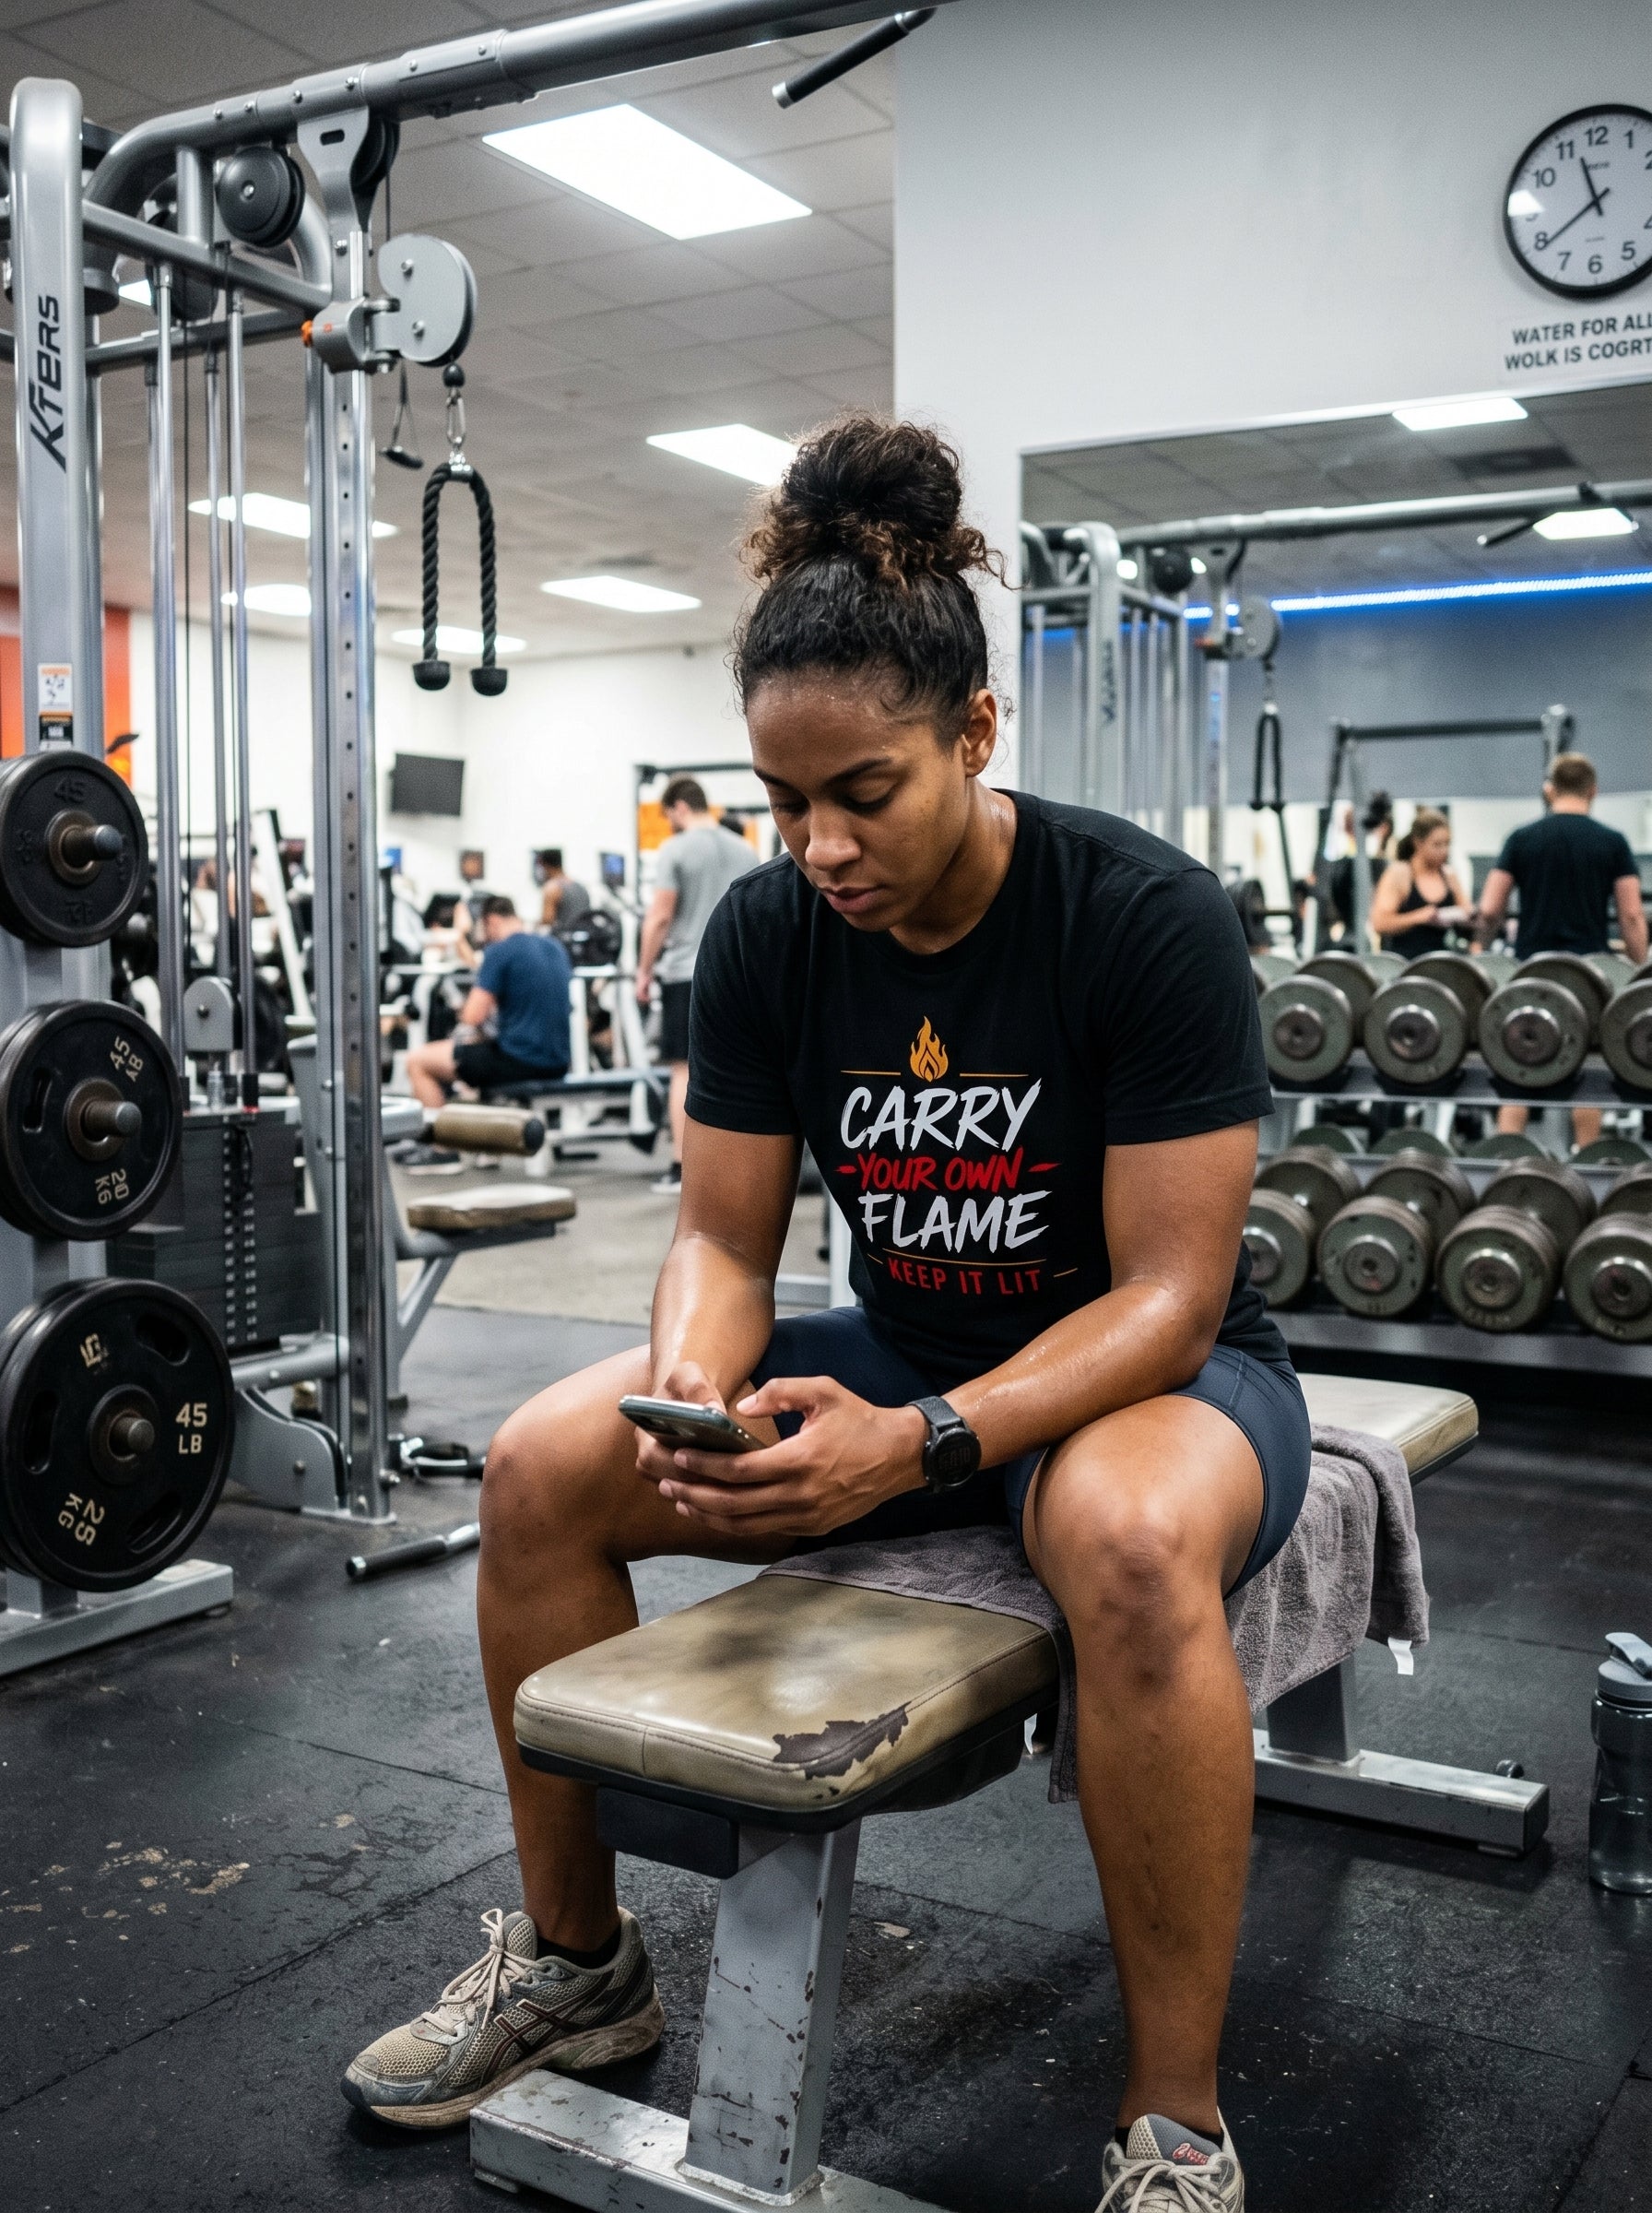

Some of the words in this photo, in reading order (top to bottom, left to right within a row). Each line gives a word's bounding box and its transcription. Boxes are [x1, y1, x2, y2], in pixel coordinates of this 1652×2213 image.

[1586, 125, 1609, 146] 12
[1625, 130, 1634, 148] 1
[1556, 140, 1575, 160] 11
[1532, 167, 1556, 188] 10
[1534, 232, 1548, 251] 8
[1621, 241, 1635, 261] 5
[1557, 251, 1572, 271] 7
[1587, 254, 1602, 274] 6
[1513, 323, 1575, 344] WATER
[1581, 317, 1617, 337] FOR
[1504, 349, 1558, 370] WOLK
[1564, 346, 1582, 363] IS
[110, 1035, 130, 1070] 45
[841, 1078, 1042, 1152] CARRY
[857, 1153, 938, 1191] YOUR
[945, 1146, 1023, 1192] OWN
[857, 1189, 1053, 1253] FLAME
[888, 1258, 946, 1290] KEEP
[959, 1271, 983, 1295] IT
[997, 1269, 1041, 1295] LIT
[175, 1403, 207, 1427] 45
[178, 1434, 202, 1454] LB
[58, 1492, 83, 1529] KG
